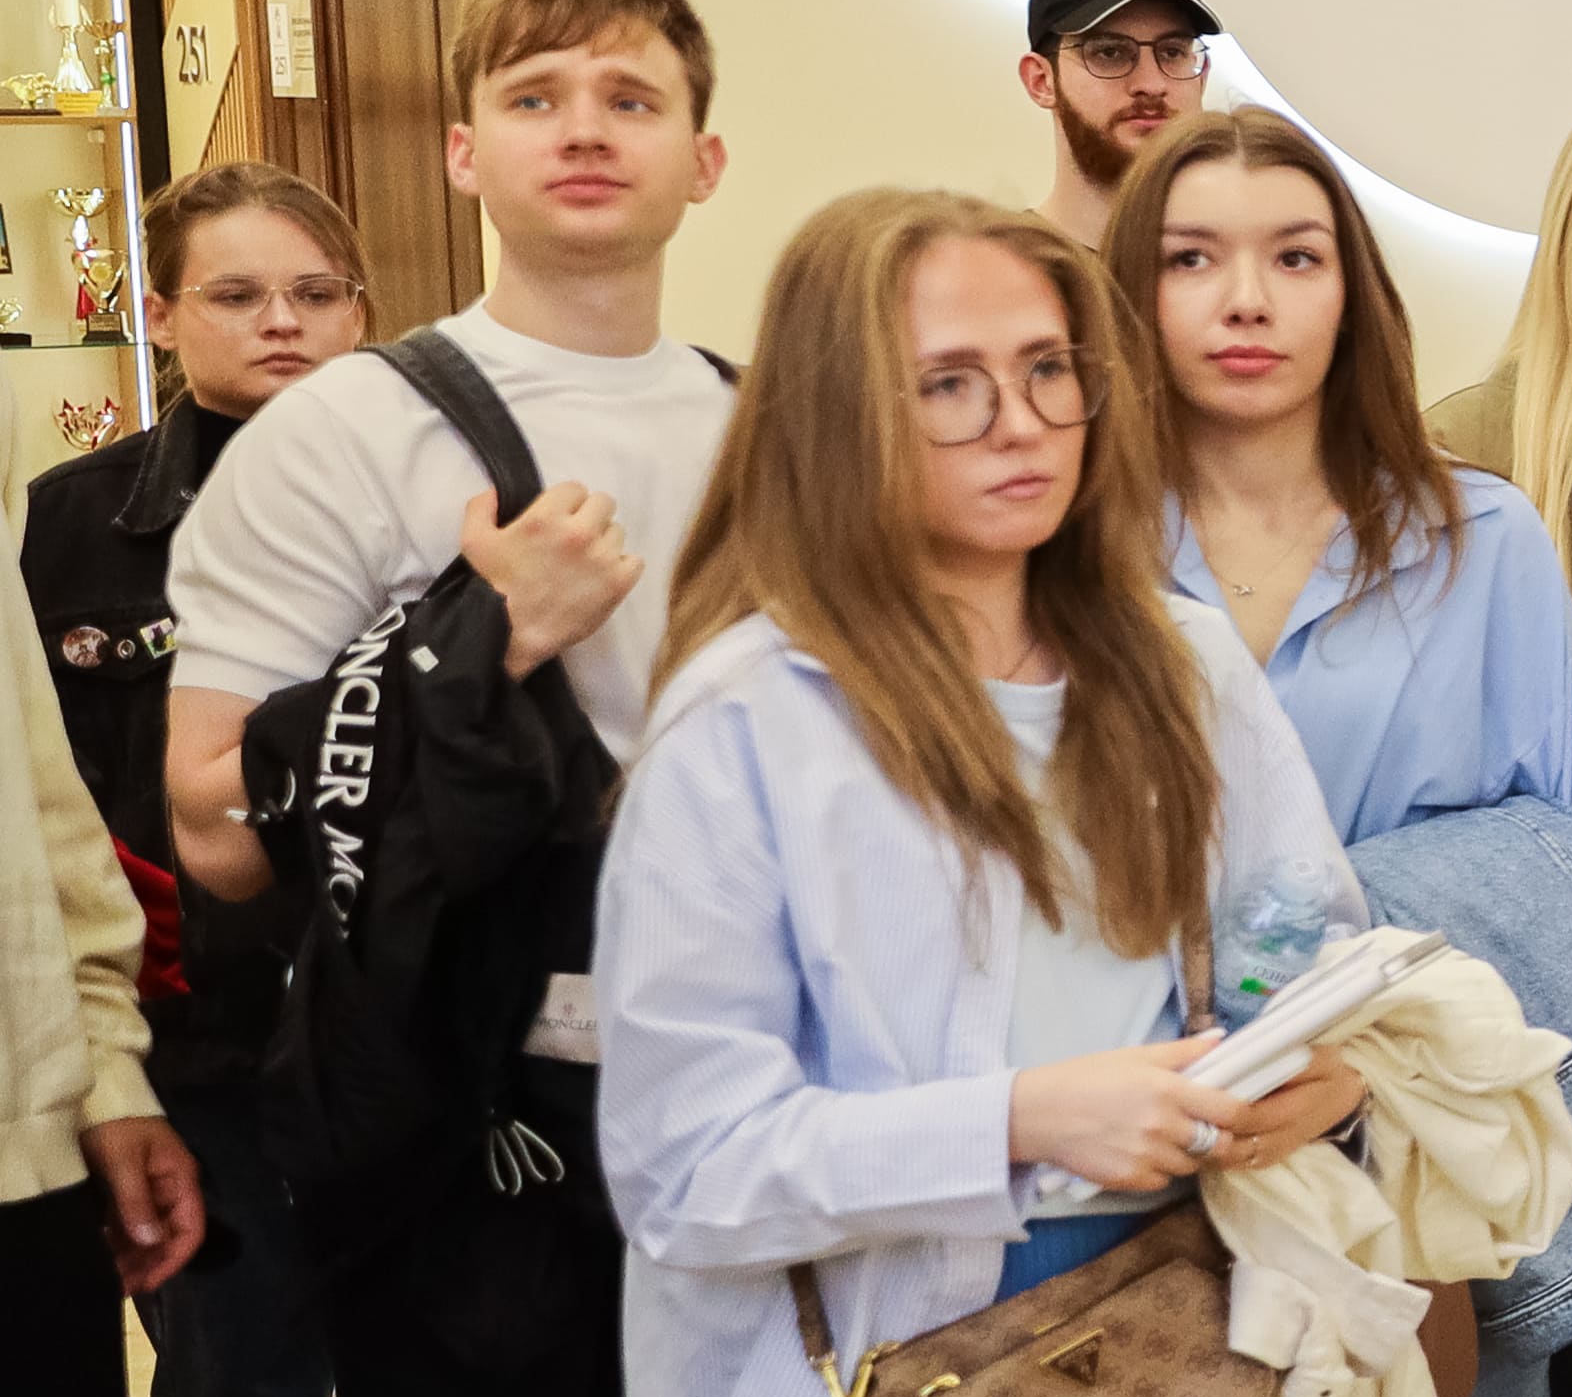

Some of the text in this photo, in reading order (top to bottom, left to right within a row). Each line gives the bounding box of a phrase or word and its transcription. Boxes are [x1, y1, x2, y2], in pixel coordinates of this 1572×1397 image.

[176, 25, 211, 82] 251
[313, 604, 407, 940] ONCLER MO
